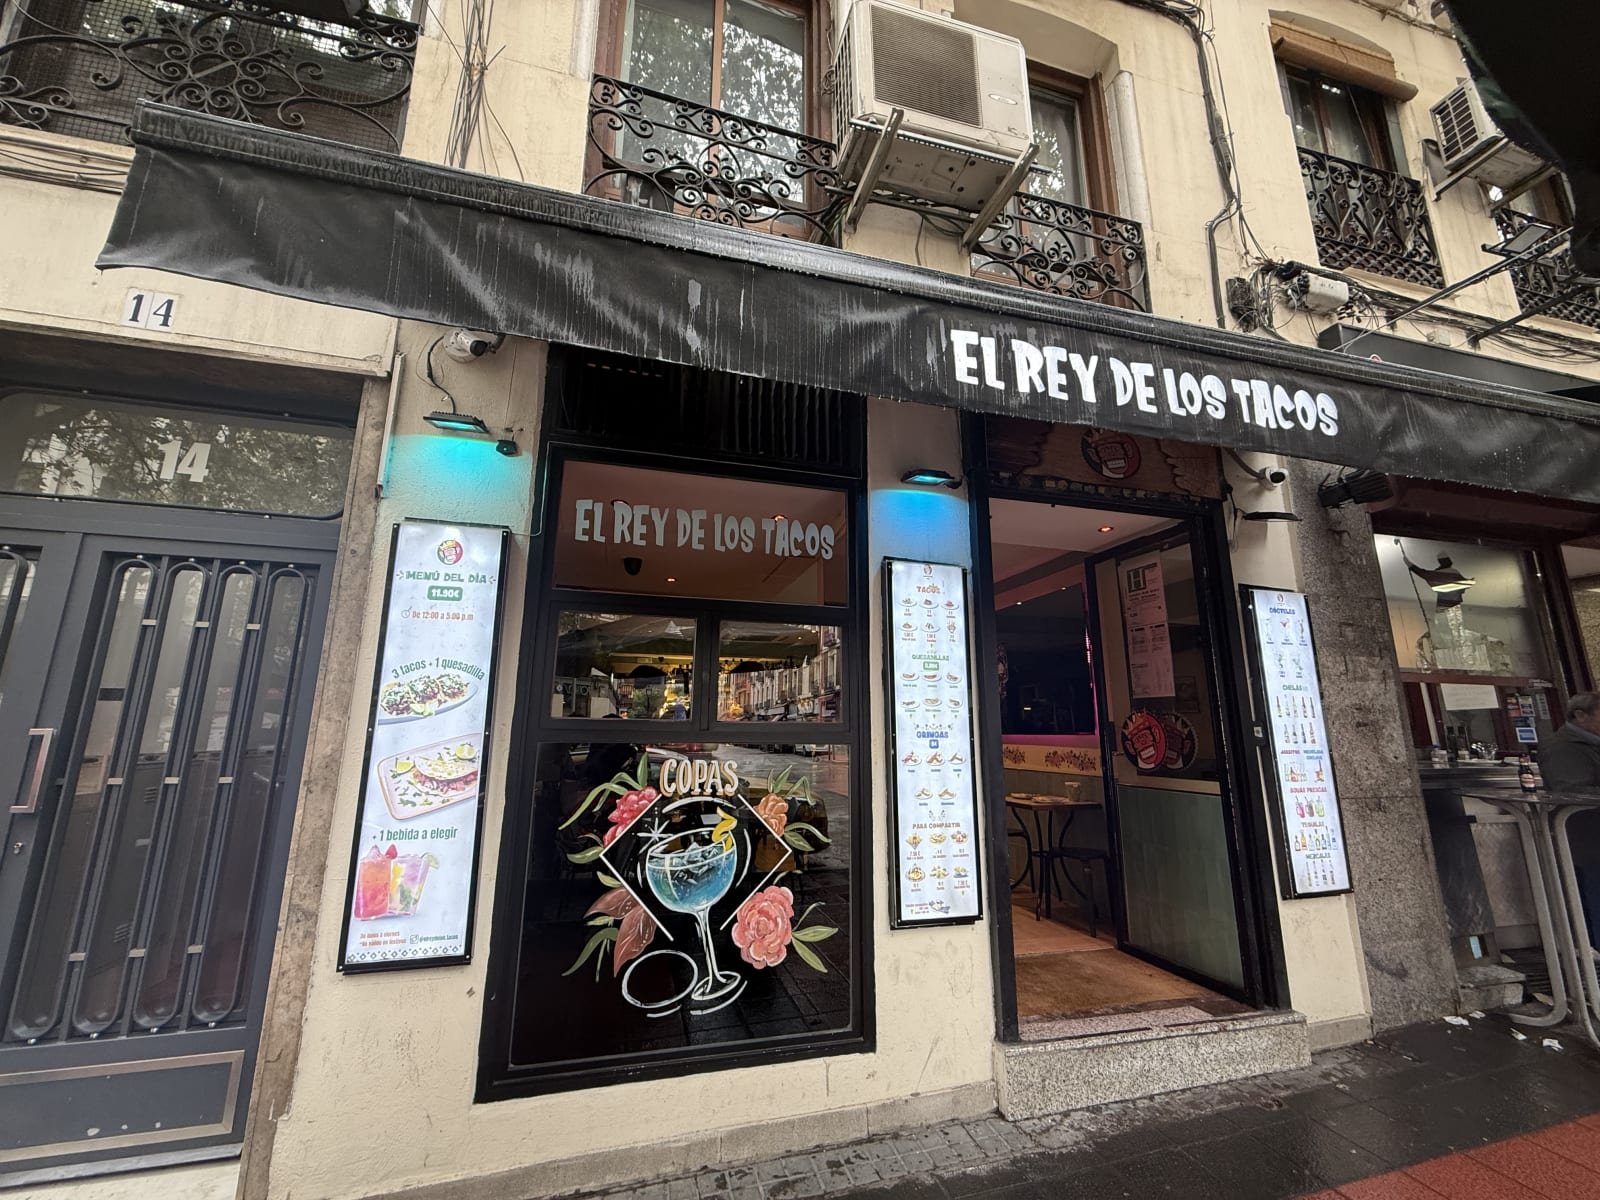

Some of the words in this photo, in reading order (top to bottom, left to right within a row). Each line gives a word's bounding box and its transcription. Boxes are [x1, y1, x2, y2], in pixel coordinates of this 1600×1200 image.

[128, 293, 175, 328] 14
[950, 329, 1005, 391] EL
[1010, 338, 1098, 403] REY
[1109, 357, 1159, 414] DE
[1163, 367, 1227, 420] LOS
[1231, 377, 1339, 437] TACOS
[158, 440, 211, 482] 14
[574, 499, 606, 543] EL
[613, 501, 670, 548] REY
[676, 508, 708, 550] DE
[714, 513, 756, 553] LOS
[761, 518, 836, 560] TACOS
[405, 570, 441, 581] MENÚ
[443, 572, 465, 583] DEL
[467, 572, 488, 584] DÍA
[391, 668, 400, 679] 3
[399, 660, 427, 675] tacos
[441, 658, 486, 681] quesadilla
[660, 758, 739, 797] COPAS
[386, 828, 419, 841] bebida
[421, 829, 428, 840] a
[430, 826, 459, 840] elegir
